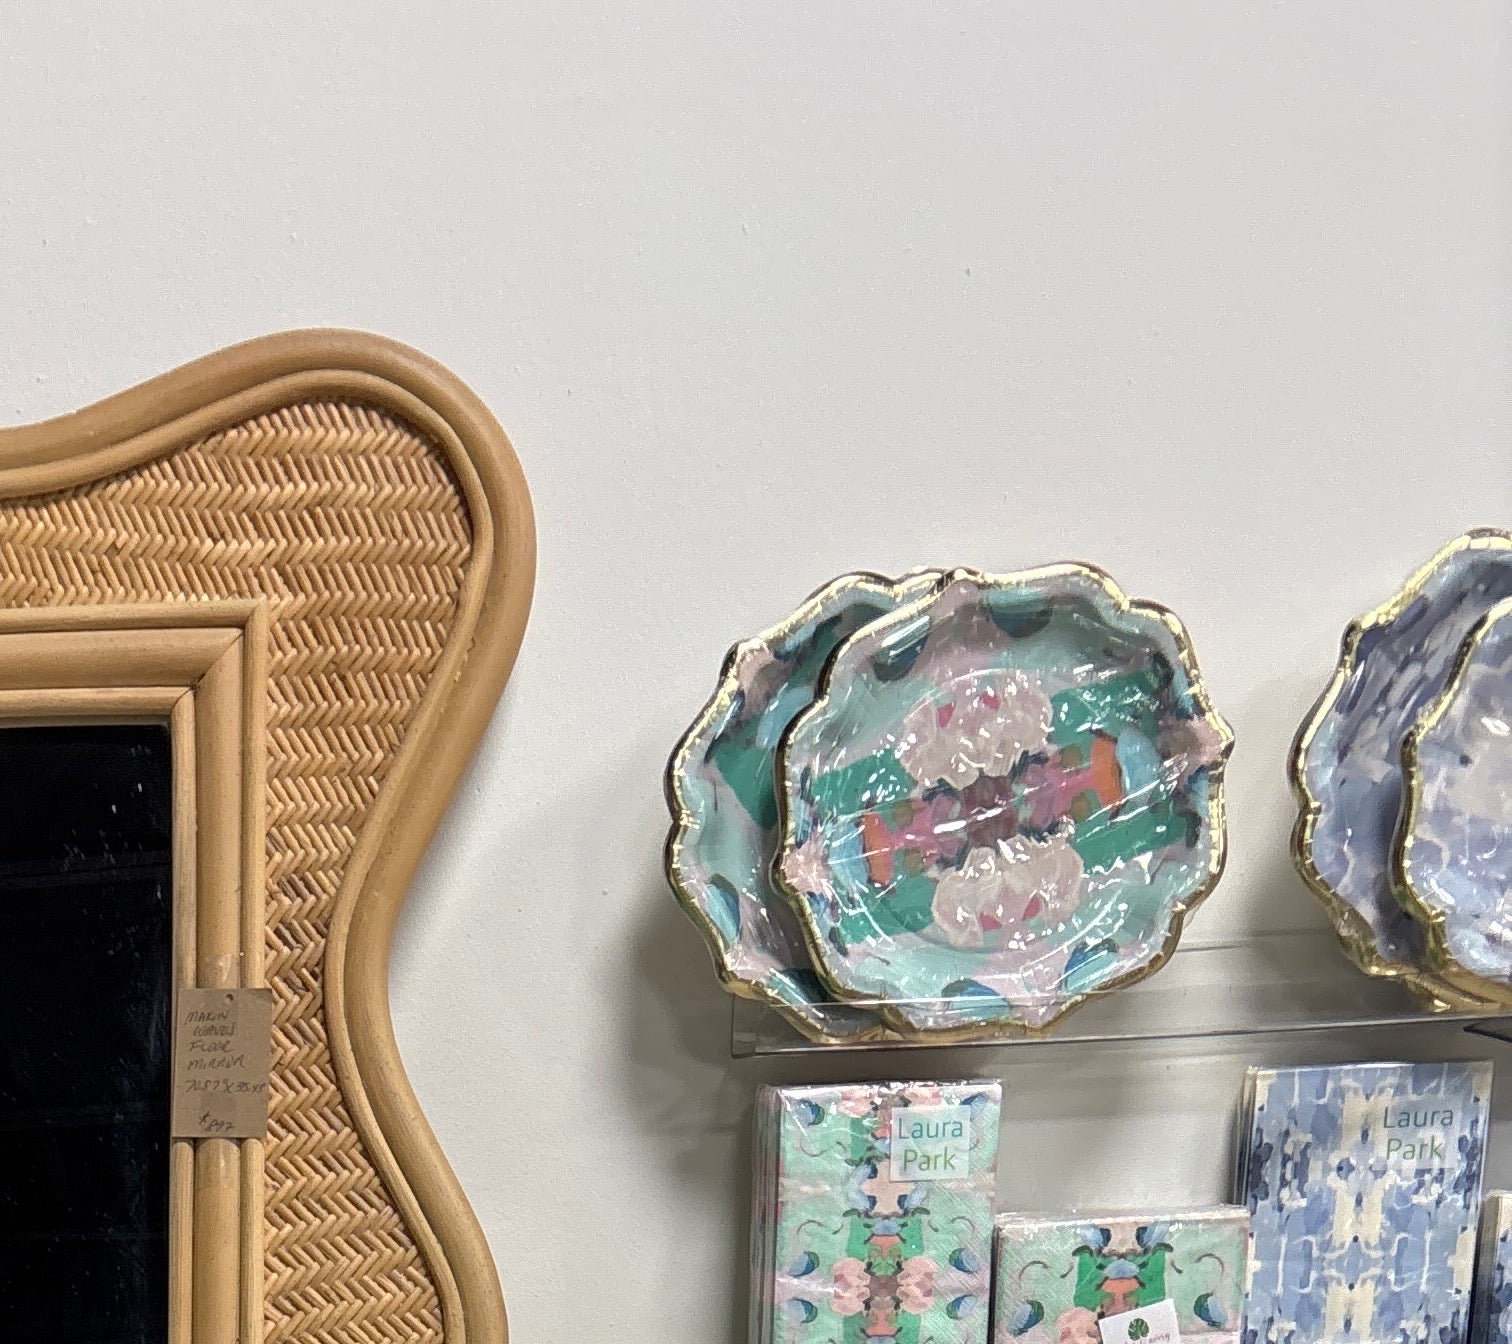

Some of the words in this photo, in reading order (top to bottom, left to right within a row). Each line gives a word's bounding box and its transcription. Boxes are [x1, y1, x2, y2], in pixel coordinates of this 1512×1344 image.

[898, 1117, 963, 1140] Laura
[1383, 1105, 1454, 1129] Laura
[903, 1145, 956, 1172] Park
[1386, 1135, 1443, 1161] Park
